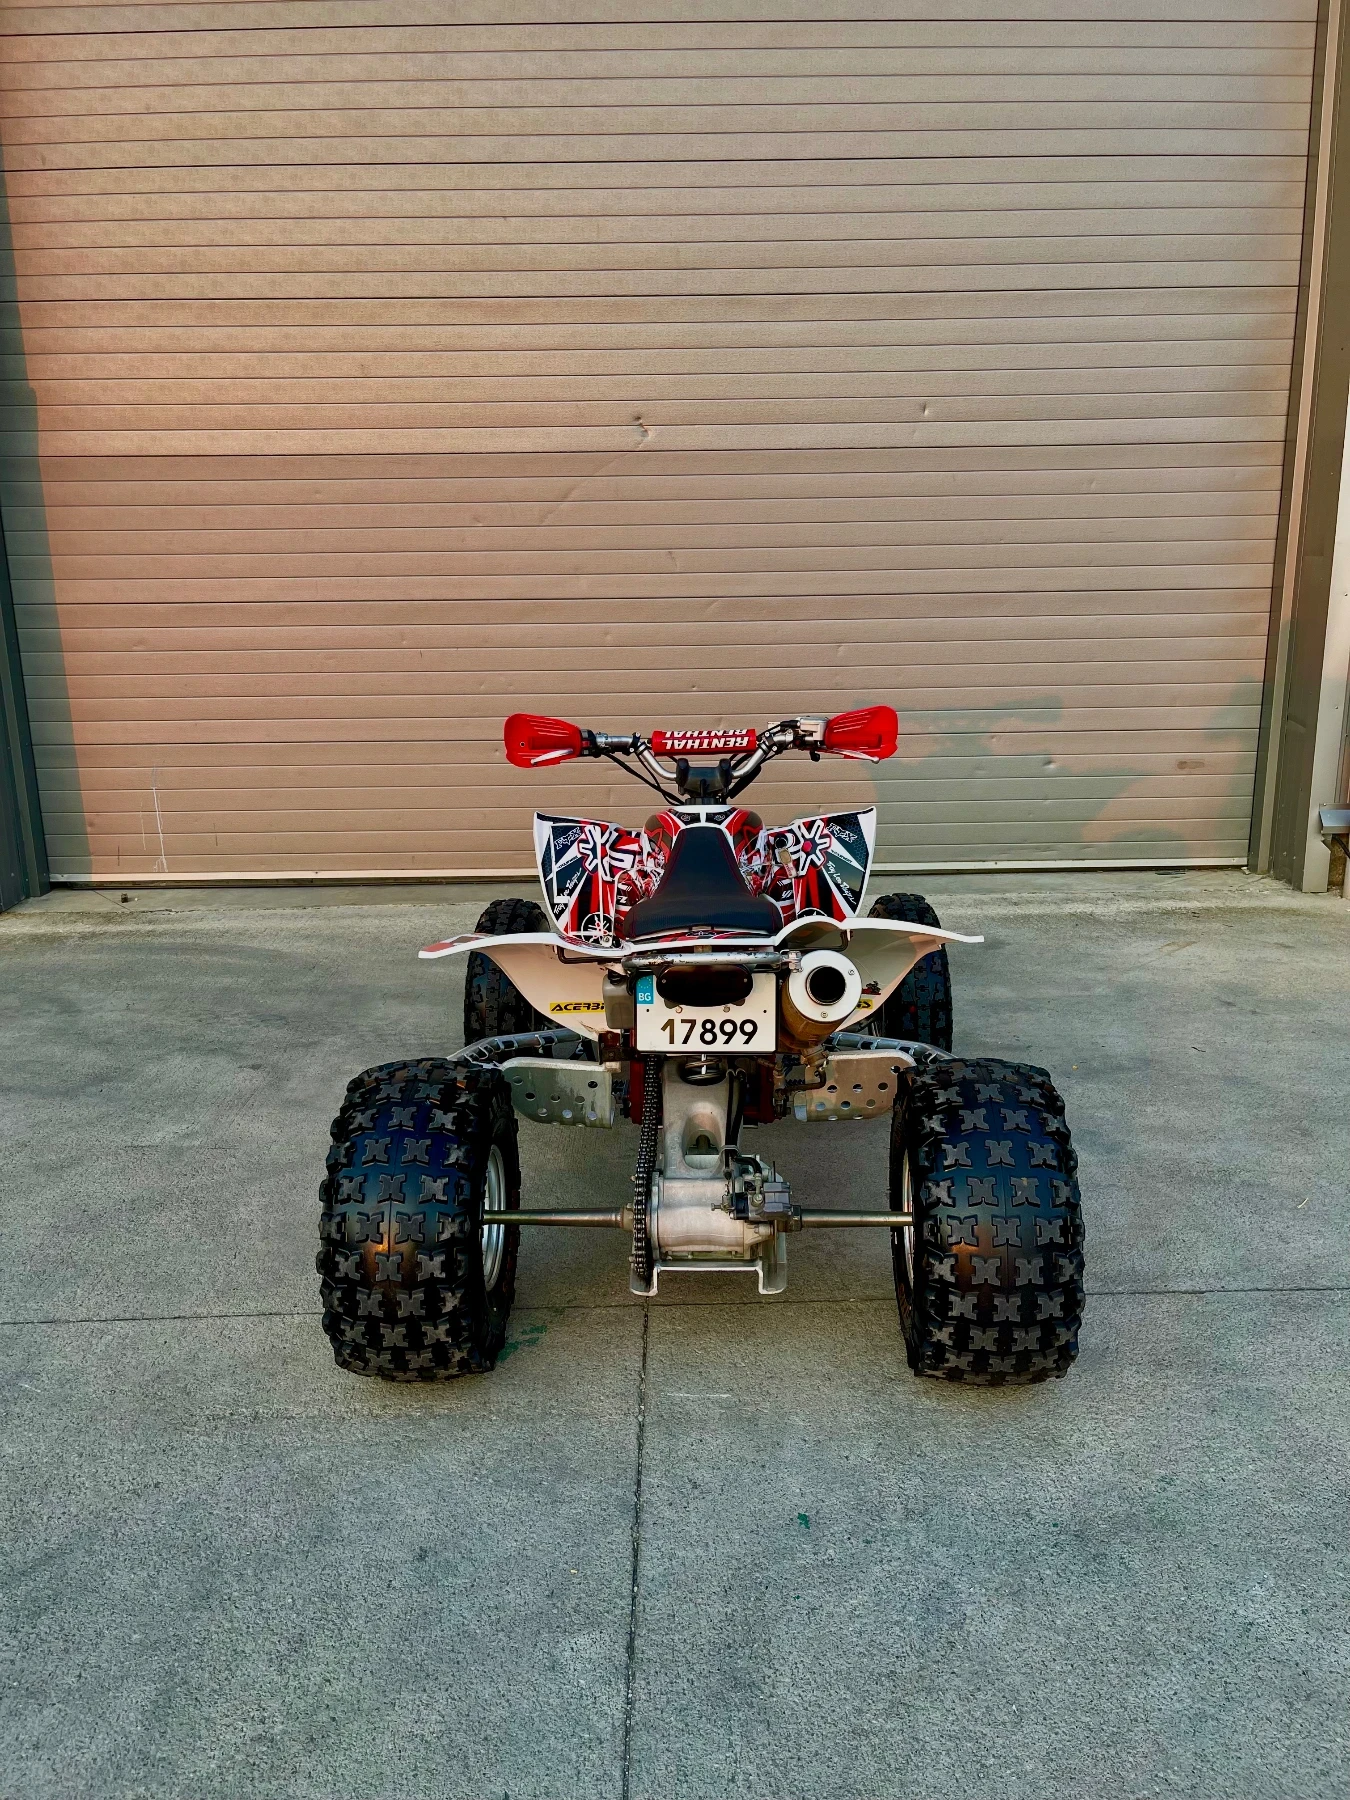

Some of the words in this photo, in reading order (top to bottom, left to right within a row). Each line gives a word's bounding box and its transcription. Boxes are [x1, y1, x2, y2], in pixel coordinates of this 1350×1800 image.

[662, 737, 749, 749] RENTHAL
[638, 992, 652, 1001] BG
[660, 1018, 759, 1045] 17899
